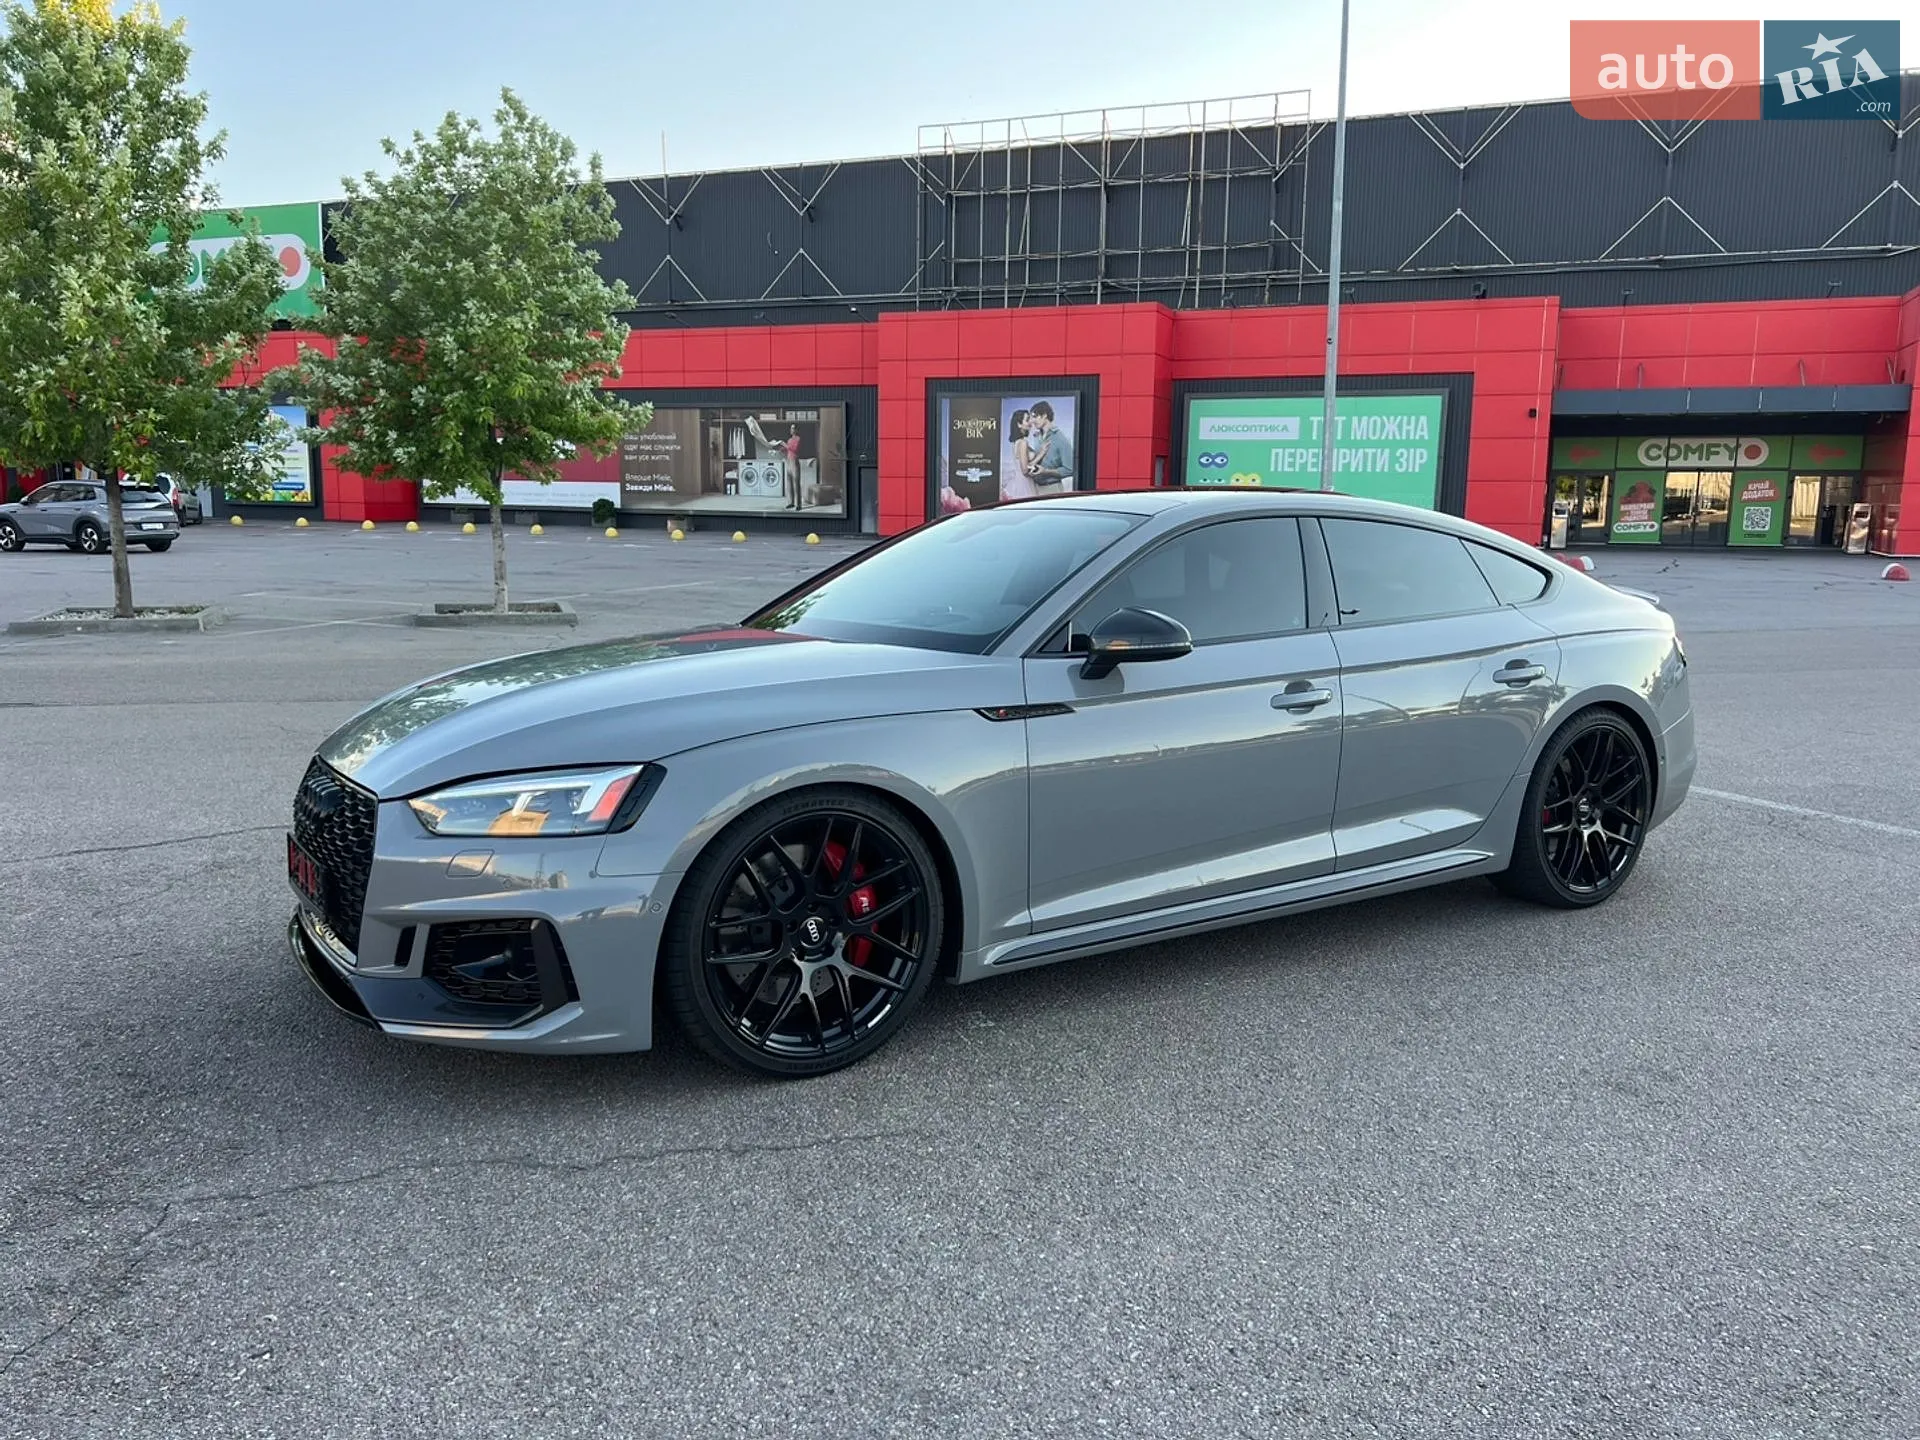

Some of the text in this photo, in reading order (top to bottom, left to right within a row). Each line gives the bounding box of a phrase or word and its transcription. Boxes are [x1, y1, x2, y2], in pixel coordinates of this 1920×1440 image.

[1209, 423, 1289, 433] ЛЮКСОПТИКА
[1309, 416, 1428, 440] ТТ МОЖНА
[1644, 442, 1742, 461] COMFY
[1395, 447, 1428, 473] ЗІР
[625, 482, 653, 492] Завжди
[1615, 522, 1648, 532] COMFY
